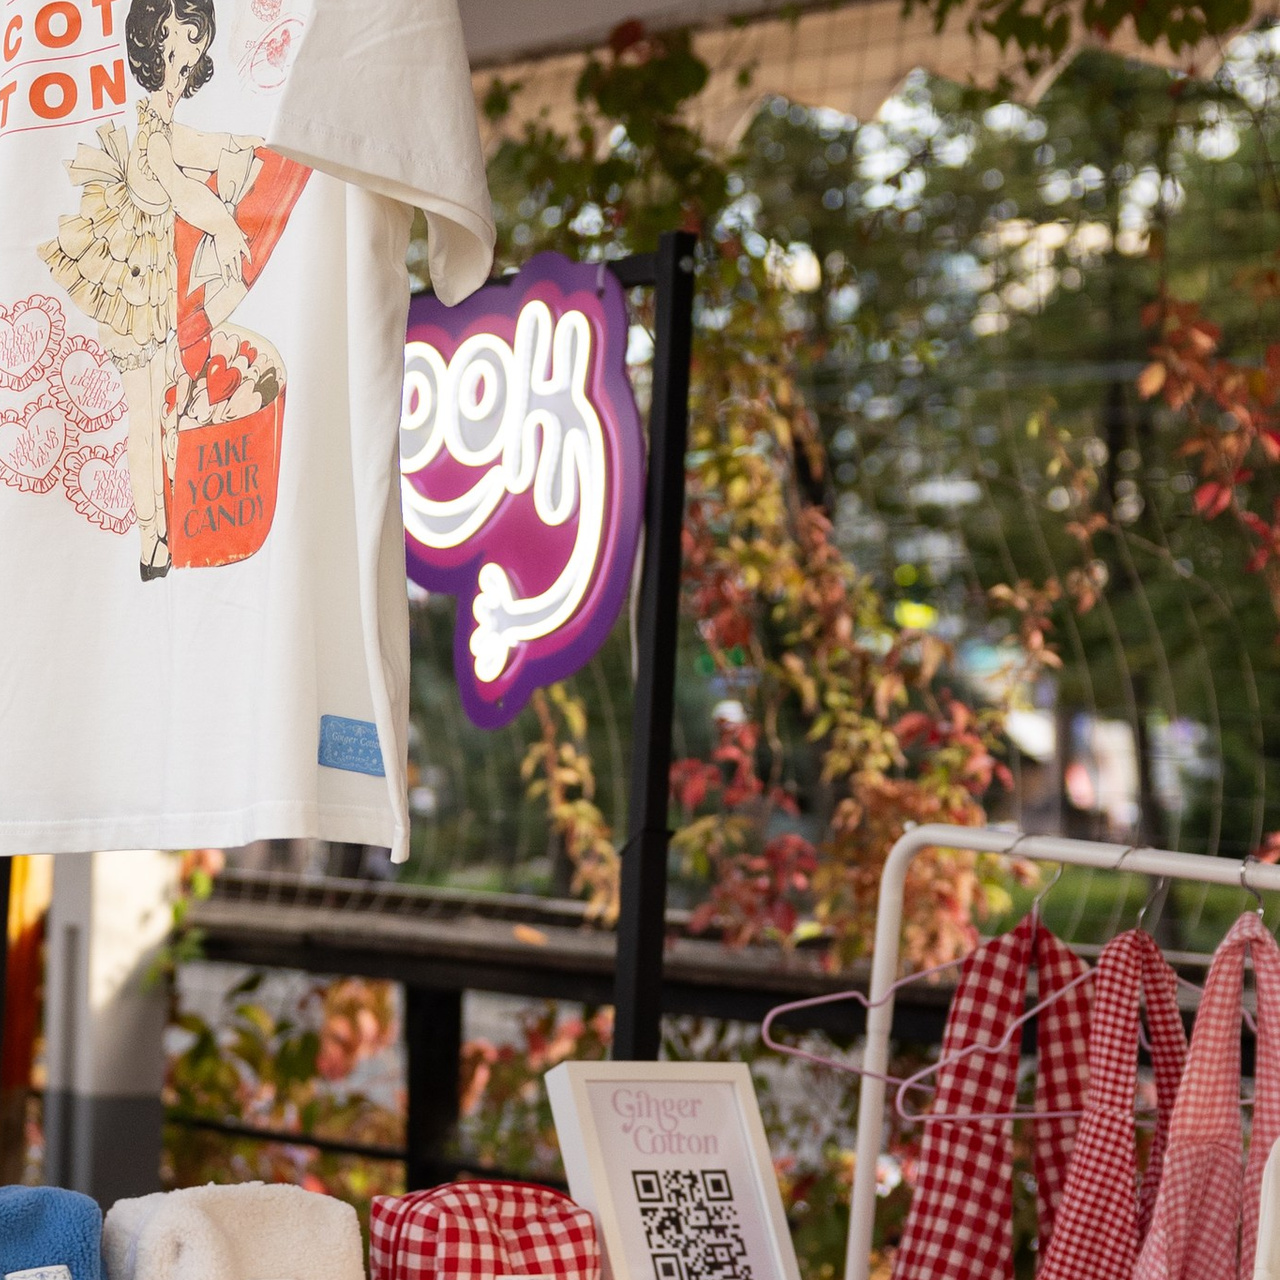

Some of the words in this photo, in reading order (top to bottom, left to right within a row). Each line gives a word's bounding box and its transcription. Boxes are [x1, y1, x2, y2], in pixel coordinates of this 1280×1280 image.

[70, 375, 104, 389] LIGHT
[106, 380, 120, 392] UP
[83, 386, 107, 399] THIS
[197, 432, 254, 472] TAKE
[187, 464, 259, 505] YOUR
[184, 494, 264, 538] CANDY
[611, 1088, 703, 1133] Ginger
[633, 1124, 718, 1155] Cotton
